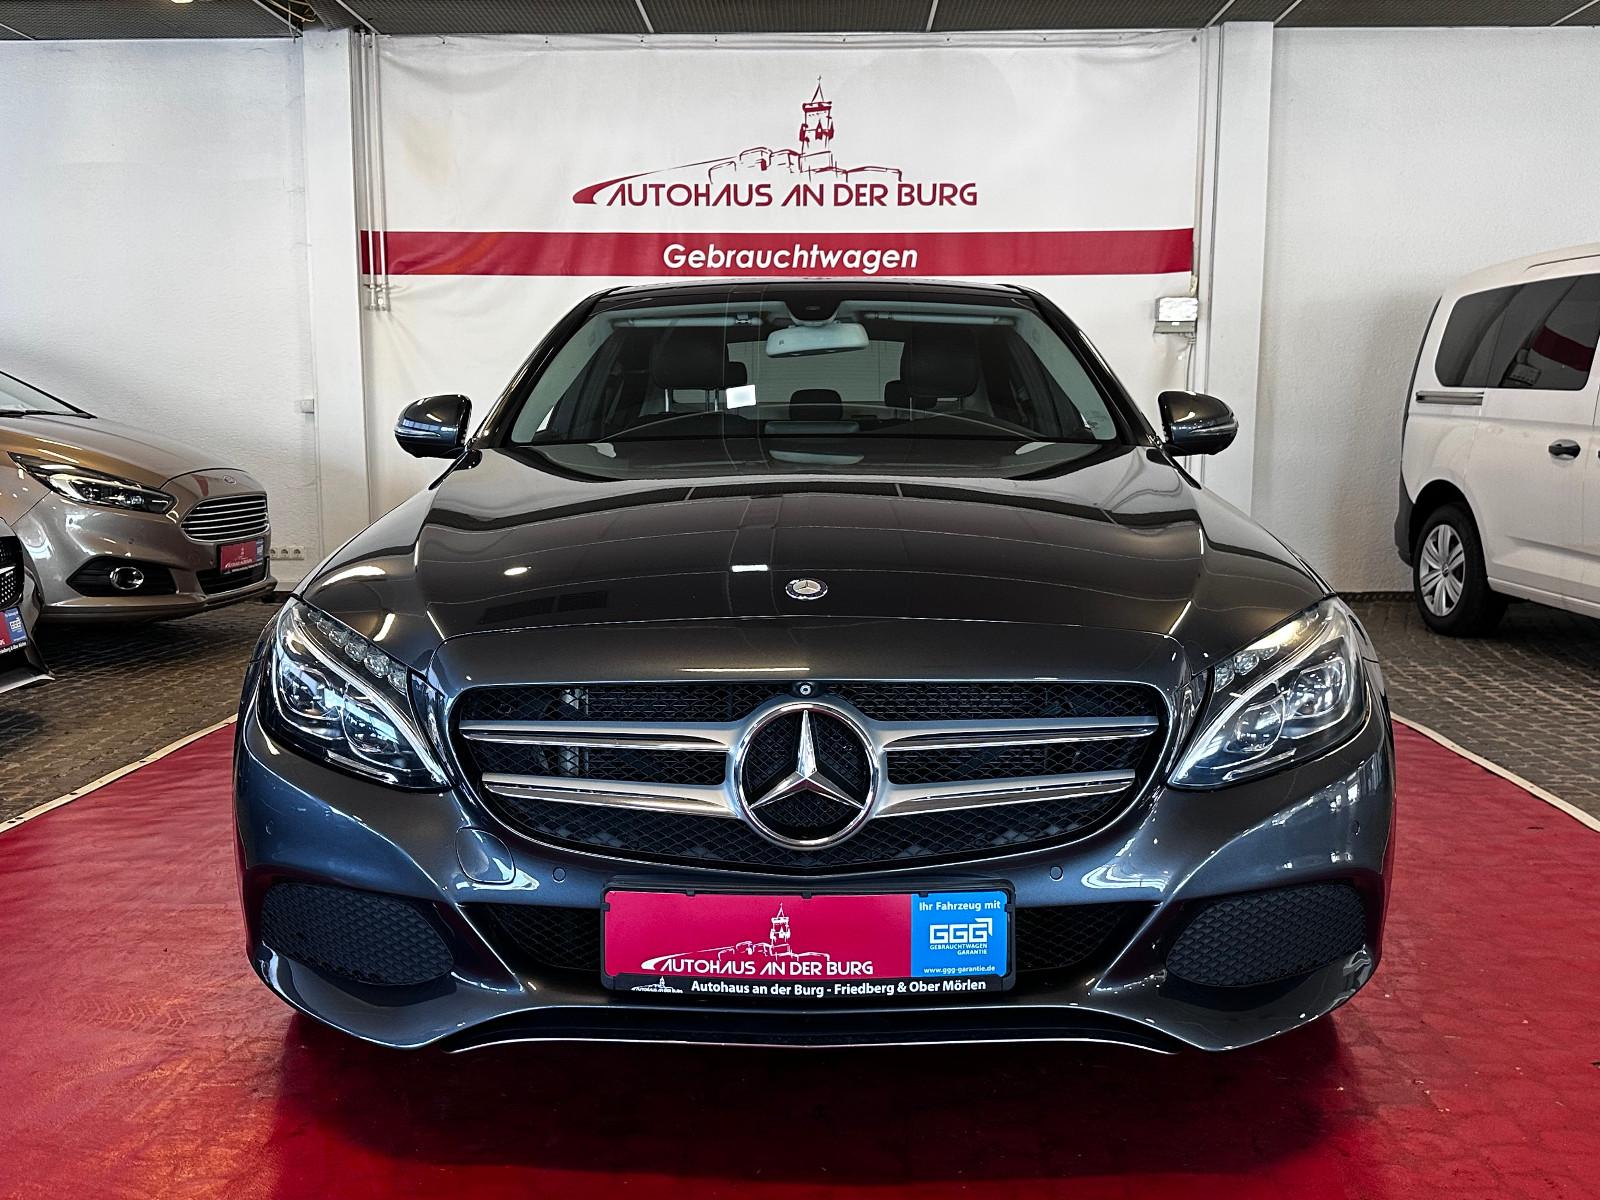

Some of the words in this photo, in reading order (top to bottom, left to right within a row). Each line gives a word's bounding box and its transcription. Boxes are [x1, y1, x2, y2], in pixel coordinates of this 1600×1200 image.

[606, 183, 772, 207] AUTOHAUS
[781, 183, 824, 207] AN
[833, 183, 889, 207] DER
[897, 182, 978, 207] BURG
[662, 243, 918, 274] Gebrauchtwagen
[919, 902, 933, 911] Ihr
[936, 901, 982, 912] Fahrzeug
[984, 900, 1001, 909] mit
[929, 923, 988, 944] GGG
[660, 959, 756, 974] AUTOHAUS
[759, 961, 786, 976] AN
[789, 961, 823, 976] DER
[826, 961, 874, 975] BURG
[923, 965, 996, 975] www.ggg-garantie.de
[691, 980, 750, 994] Autohaus
[752, 985, 768, 995] an
[770, 983, 792, 996] der
[794, 985, 824, 998] Burg
[834, 982, 895, 996] Friedberg
[897, 982, 907, 993] &
[909, 981, 940, 993] Ober
[942, 979, 987, 992] Mörlen
